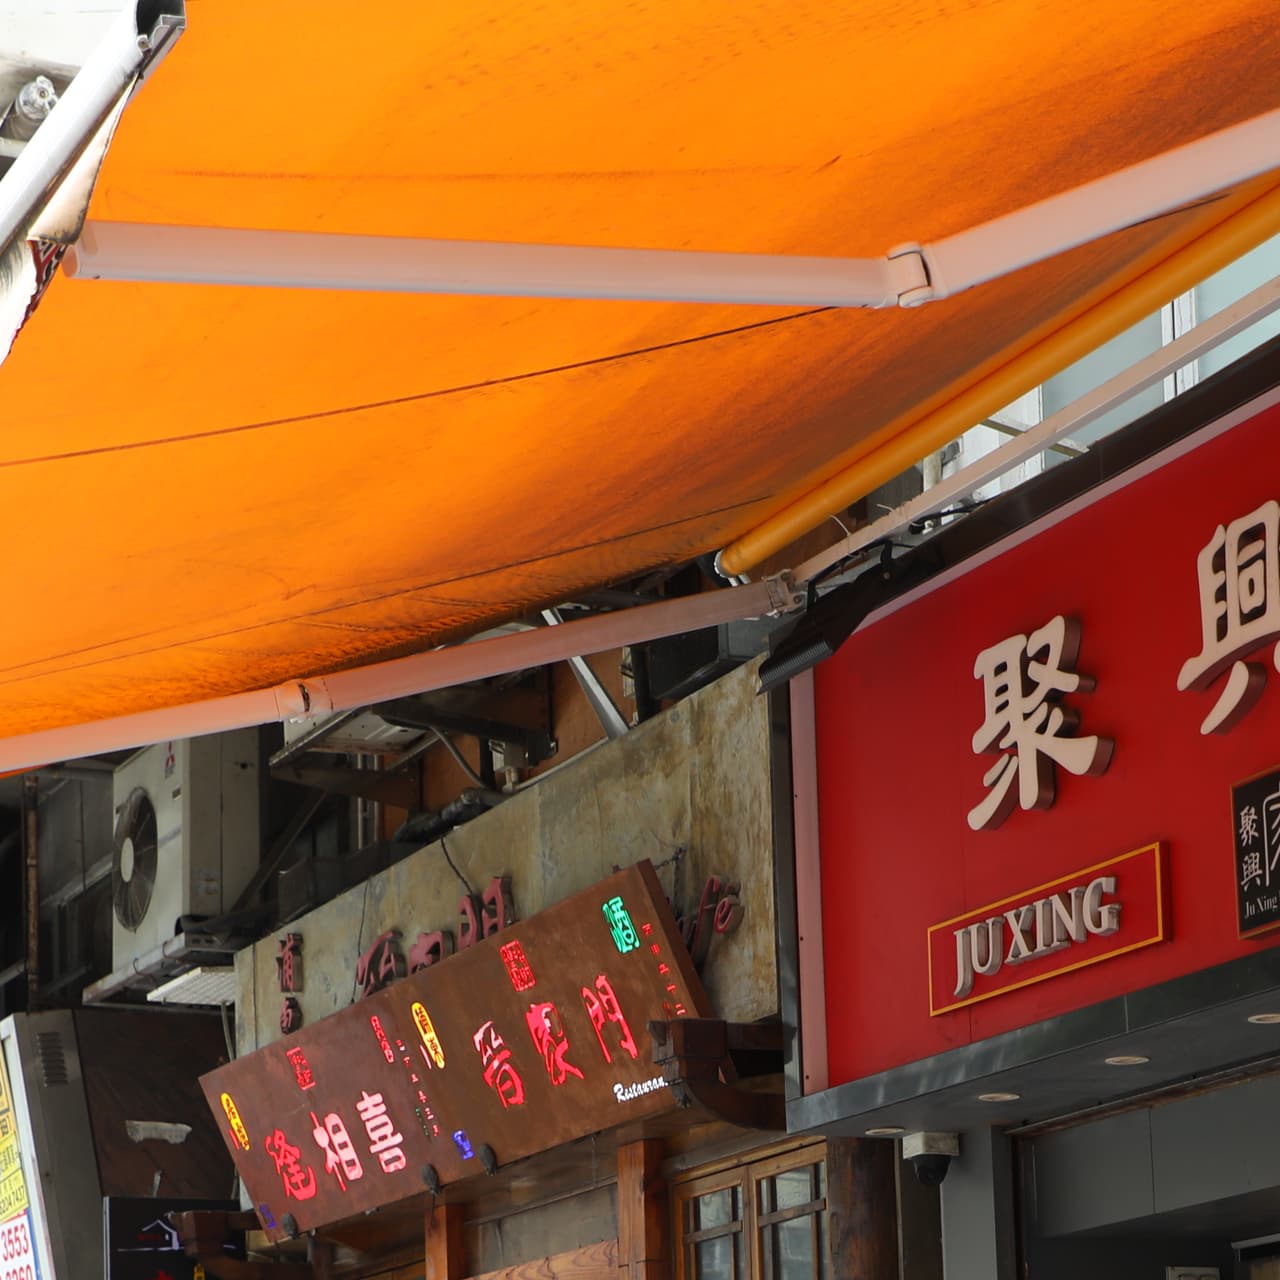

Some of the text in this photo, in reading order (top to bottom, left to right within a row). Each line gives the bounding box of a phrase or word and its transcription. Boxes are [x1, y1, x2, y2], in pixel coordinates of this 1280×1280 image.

[1244, 901, 1255, 919] Ju
[1257, 895, 1277, 912] Xing
[614, 1076, 668, 1102] Restauran
[0, 1224, 30, 1263] 3553
